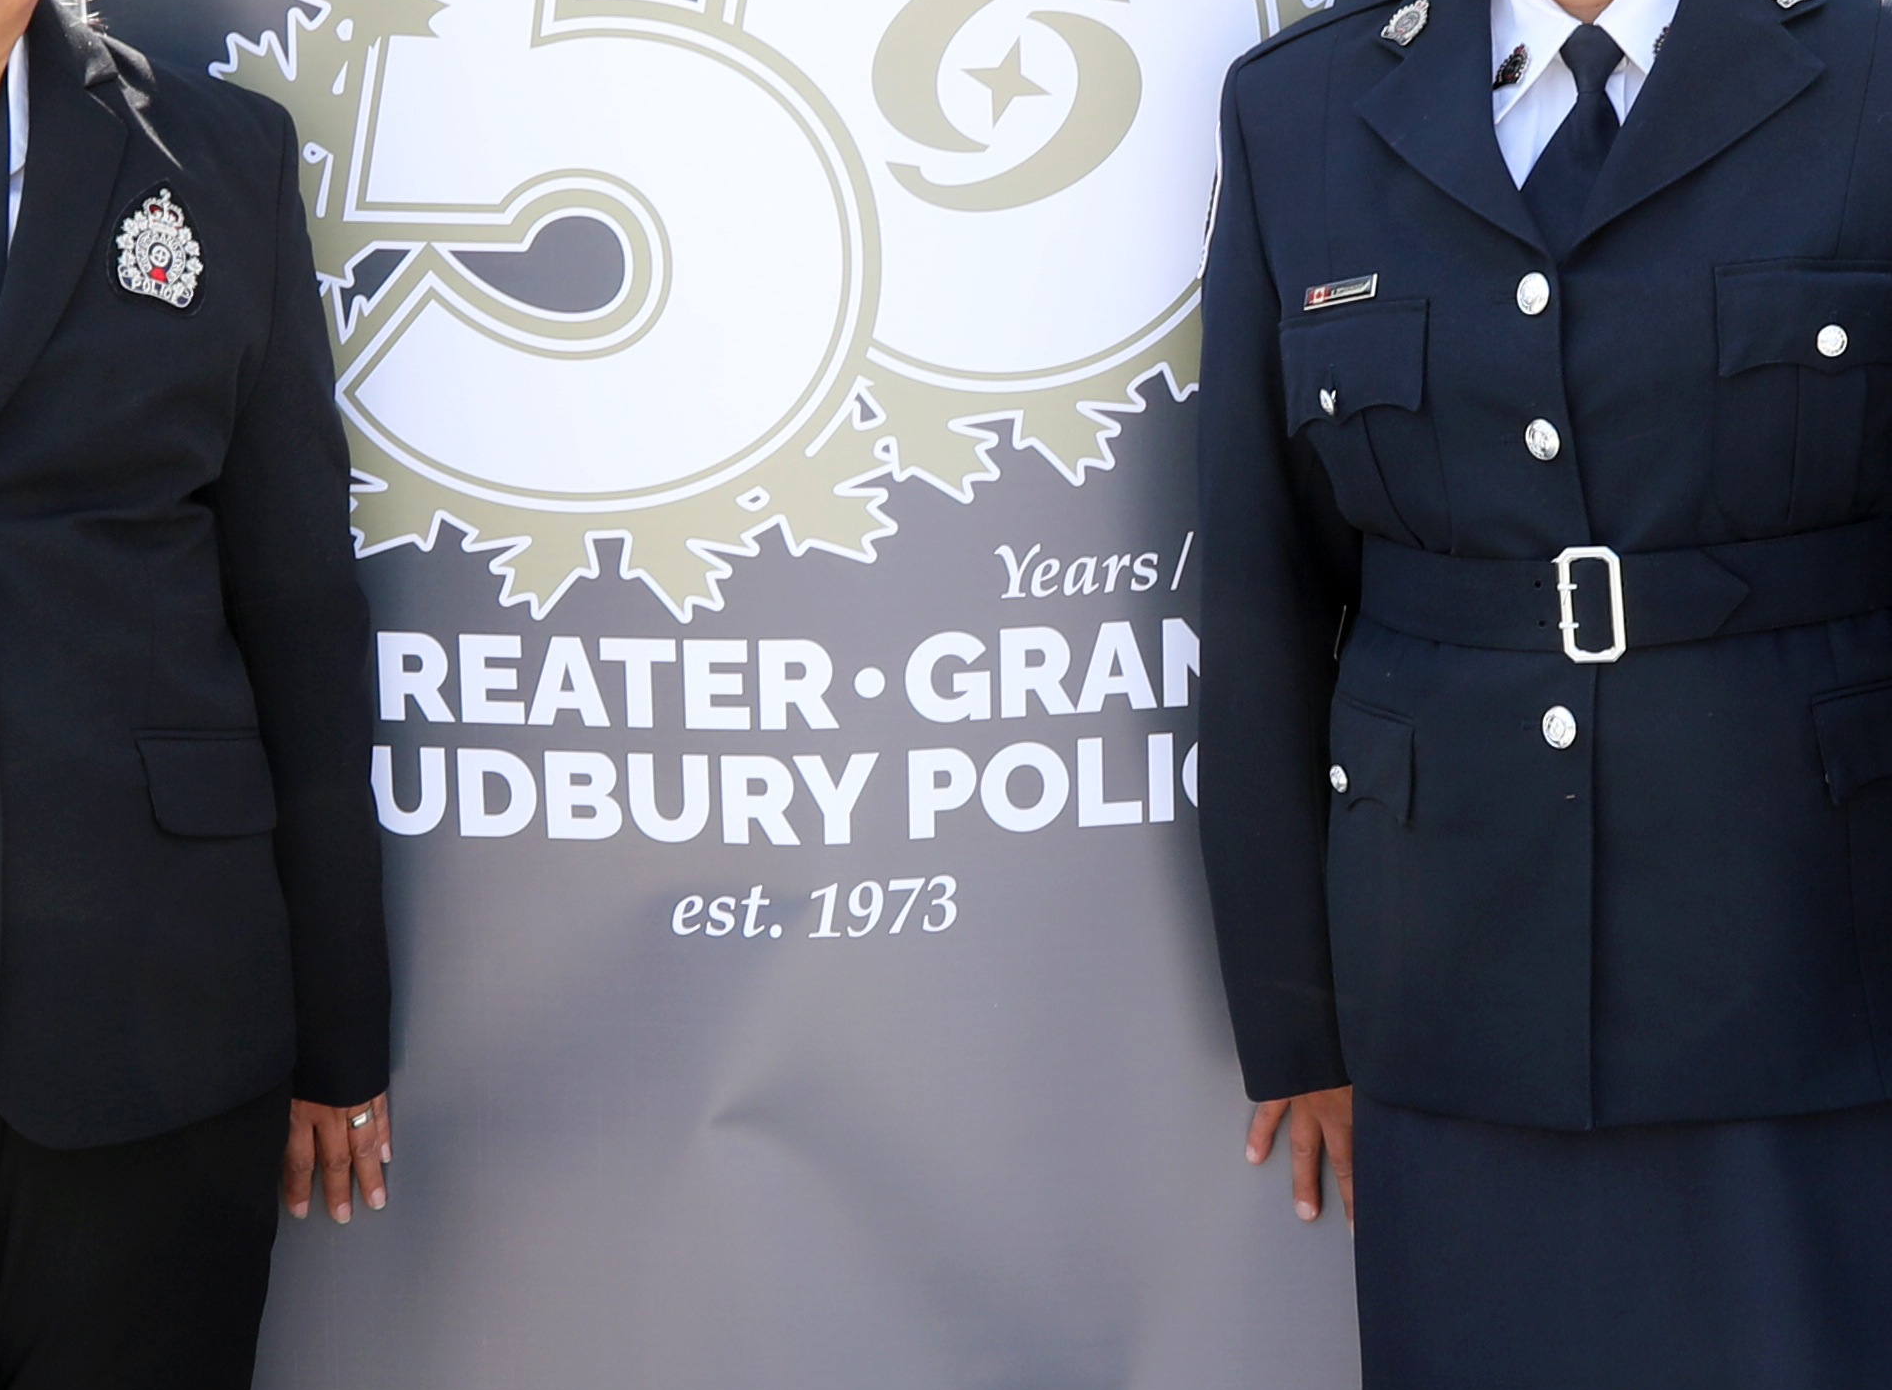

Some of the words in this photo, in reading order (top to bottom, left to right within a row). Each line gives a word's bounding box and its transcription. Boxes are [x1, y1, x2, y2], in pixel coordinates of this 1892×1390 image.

[993, 543, 1158, 599] Years
[907, 732, 1198, 840] POLI
[671, 884, 783, 939] est.
[808, 874, 958, 939] 1973
